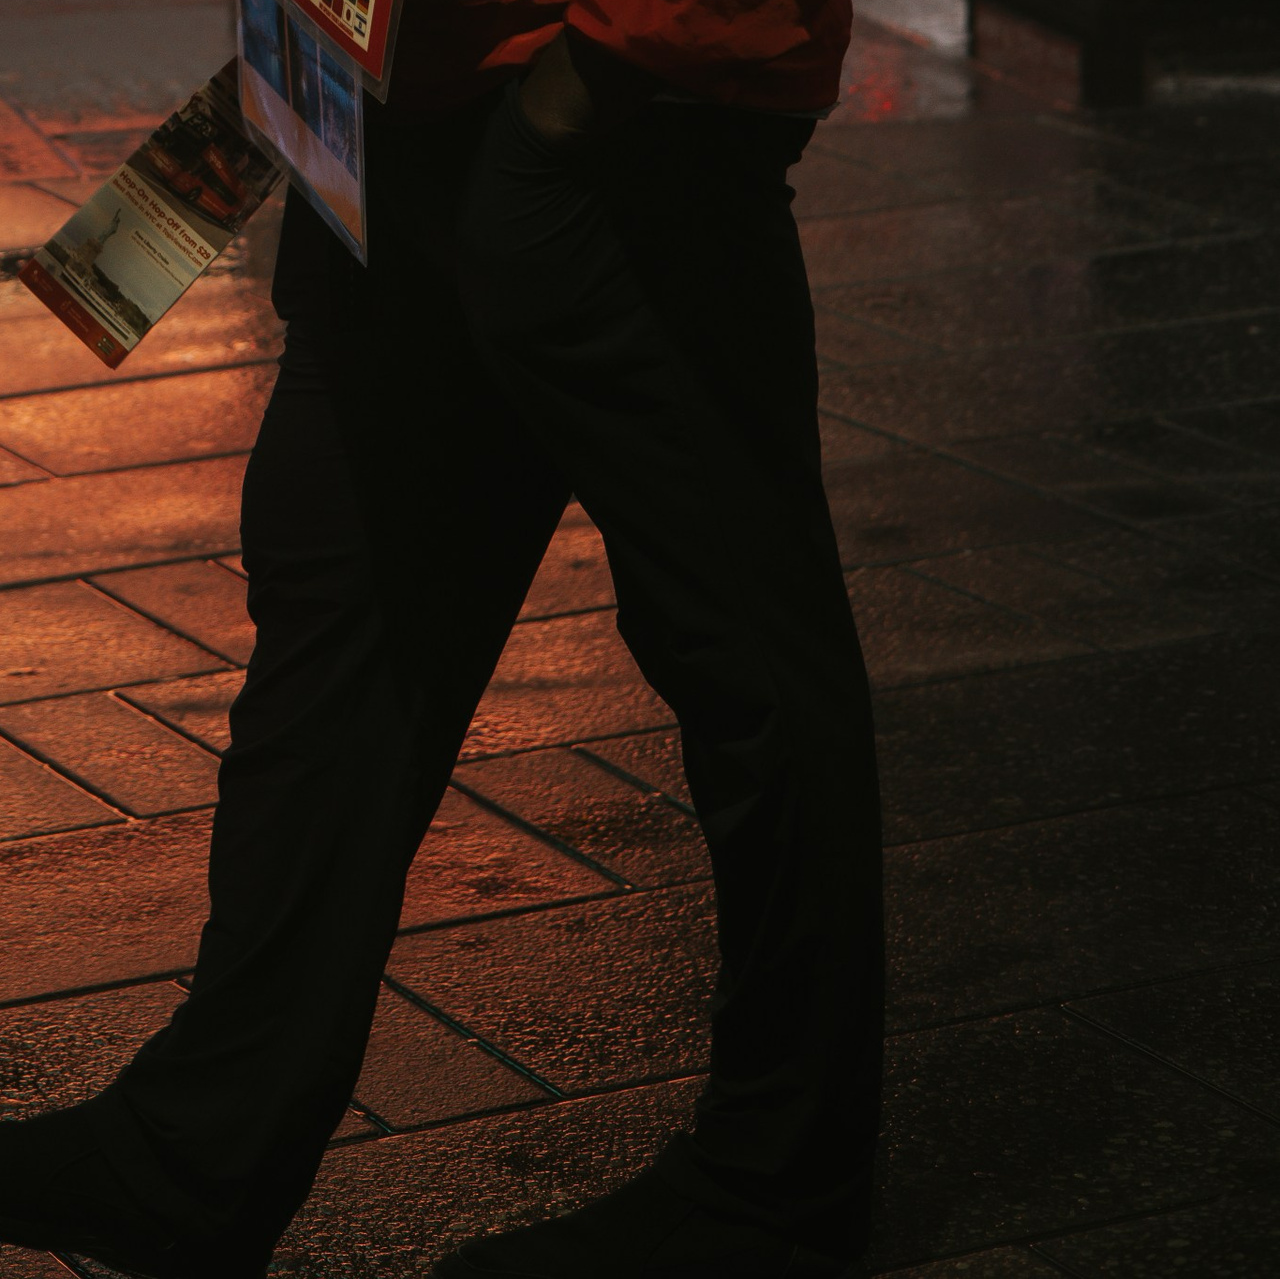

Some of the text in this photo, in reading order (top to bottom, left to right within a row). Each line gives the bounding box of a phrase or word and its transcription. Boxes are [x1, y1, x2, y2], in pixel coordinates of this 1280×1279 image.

[119, 170, 212, 260] Hop-On Hop-Off from $29
[125, 191, 139, 207] Price
[144, 211, 156, 225] NYC
